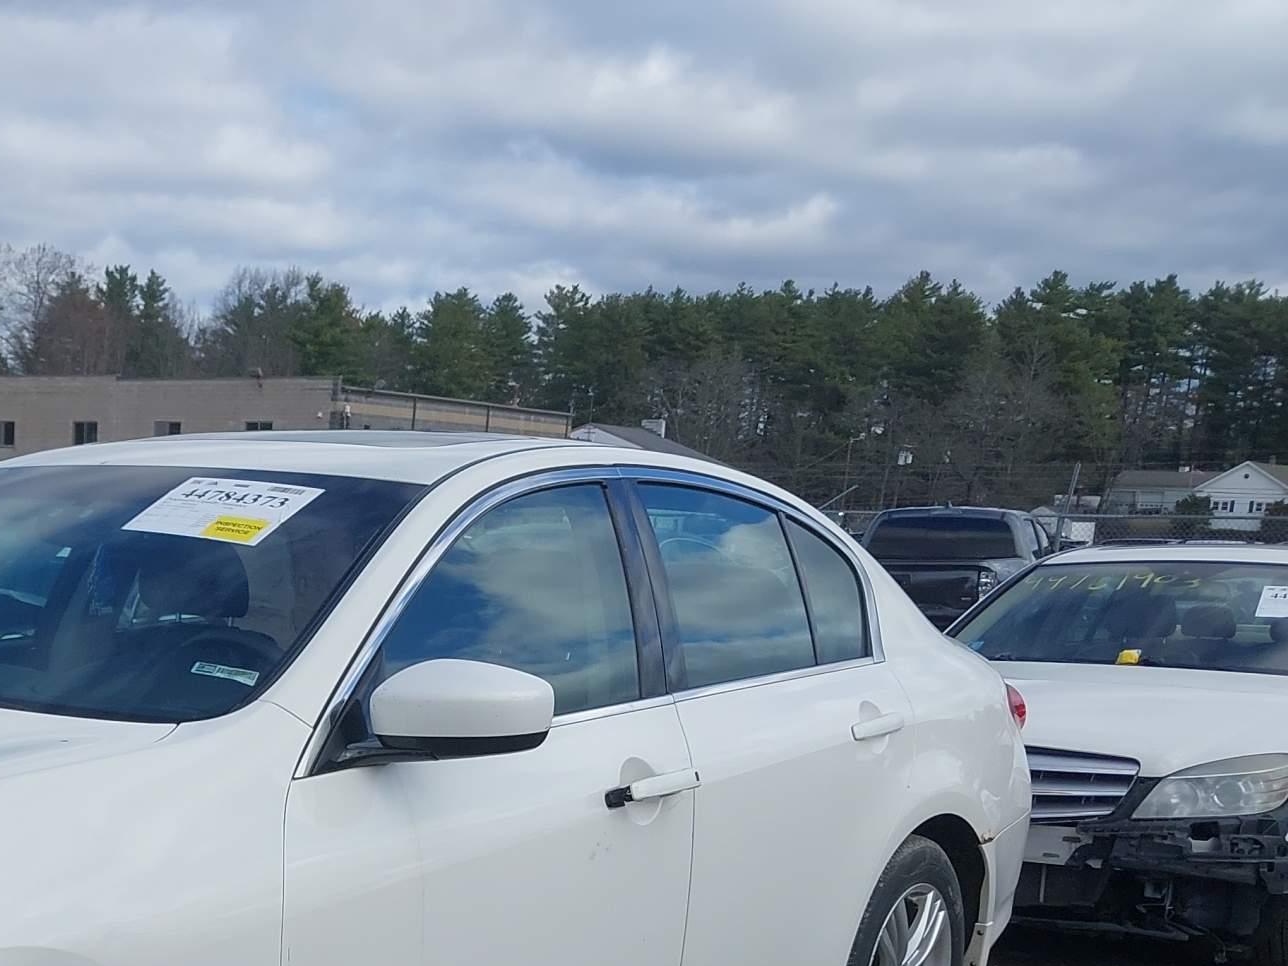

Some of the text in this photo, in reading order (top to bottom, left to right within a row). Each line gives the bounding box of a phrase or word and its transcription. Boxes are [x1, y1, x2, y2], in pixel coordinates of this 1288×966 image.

[181, 488, 290, 508] 44784373
[215, 526, 250, 535] SERVICE
[216, 520, 263, 531] INSPECTION
